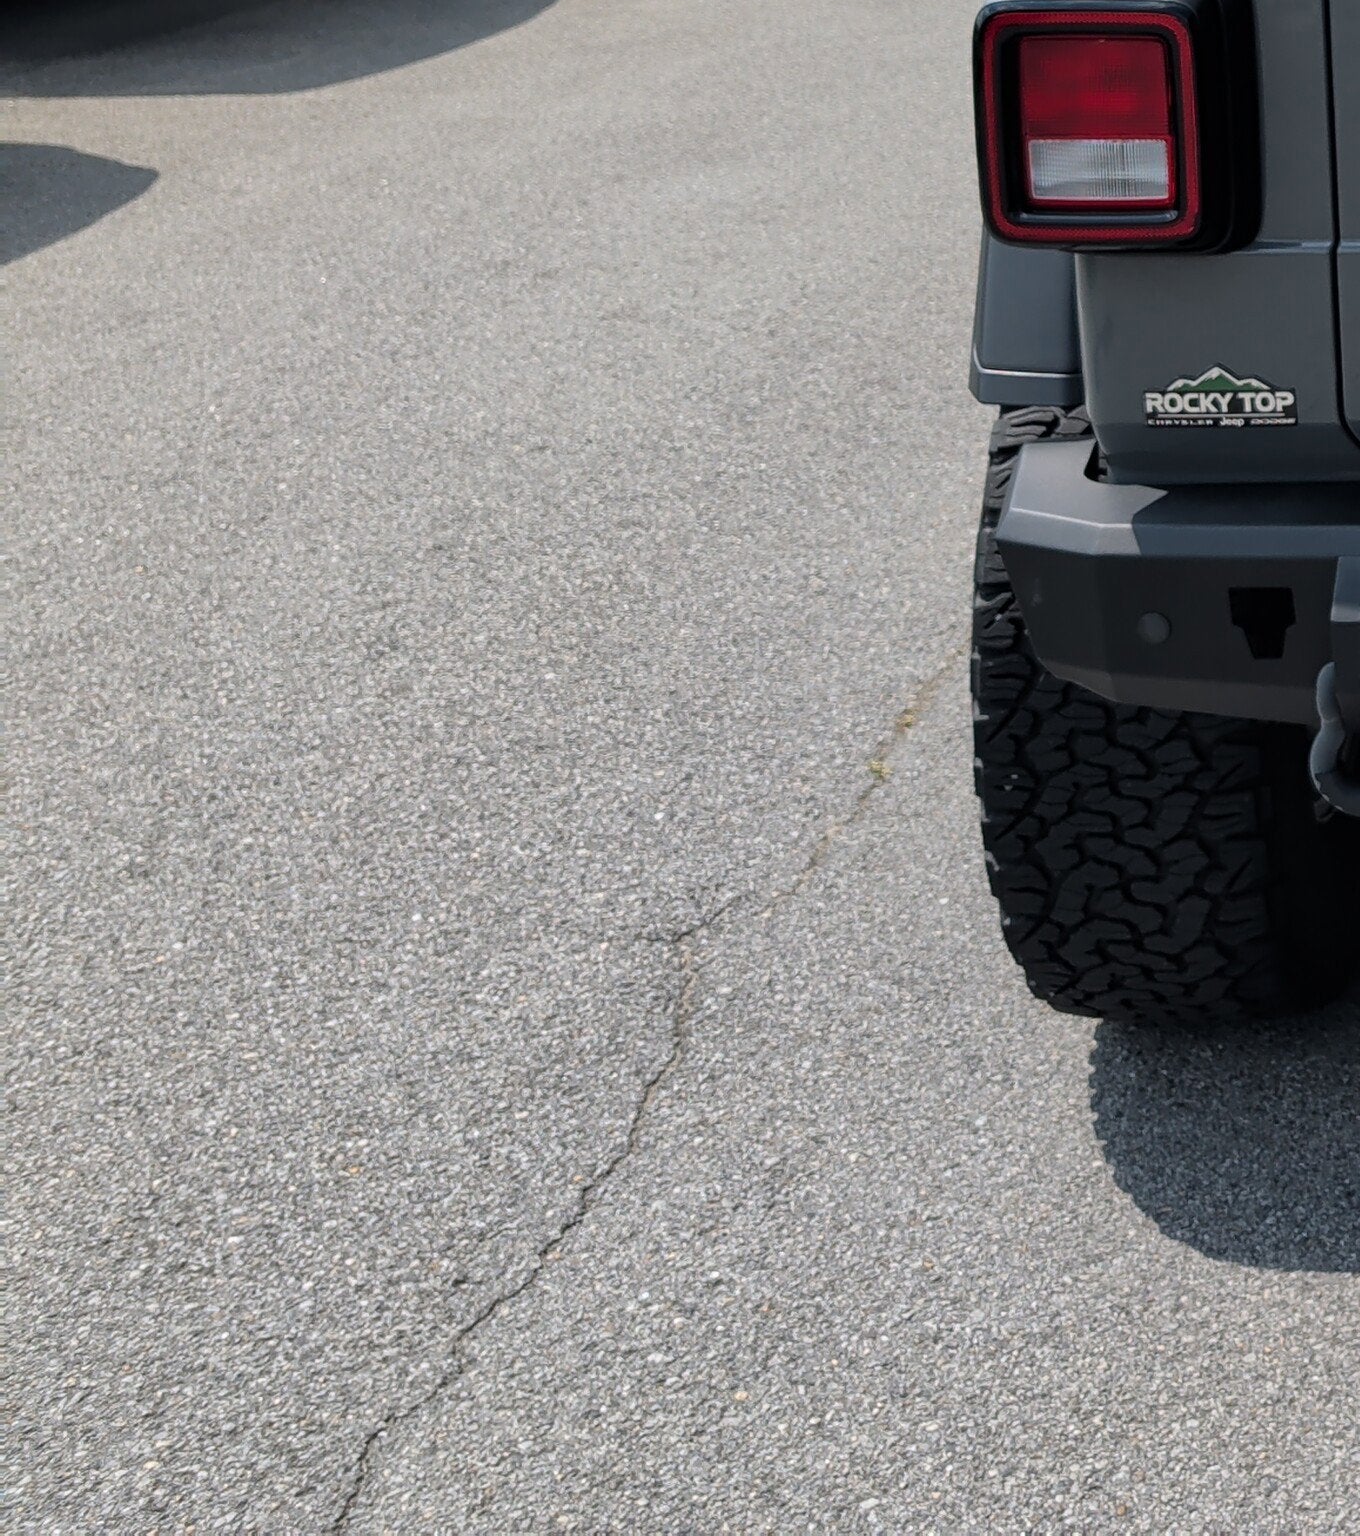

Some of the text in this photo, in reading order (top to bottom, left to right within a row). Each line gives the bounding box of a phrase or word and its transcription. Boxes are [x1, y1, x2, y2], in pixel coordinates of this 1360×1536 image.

[1145, 391, 1295, 413] ROCKY TOP
[1219, 416, 1245, 427] Jeep
